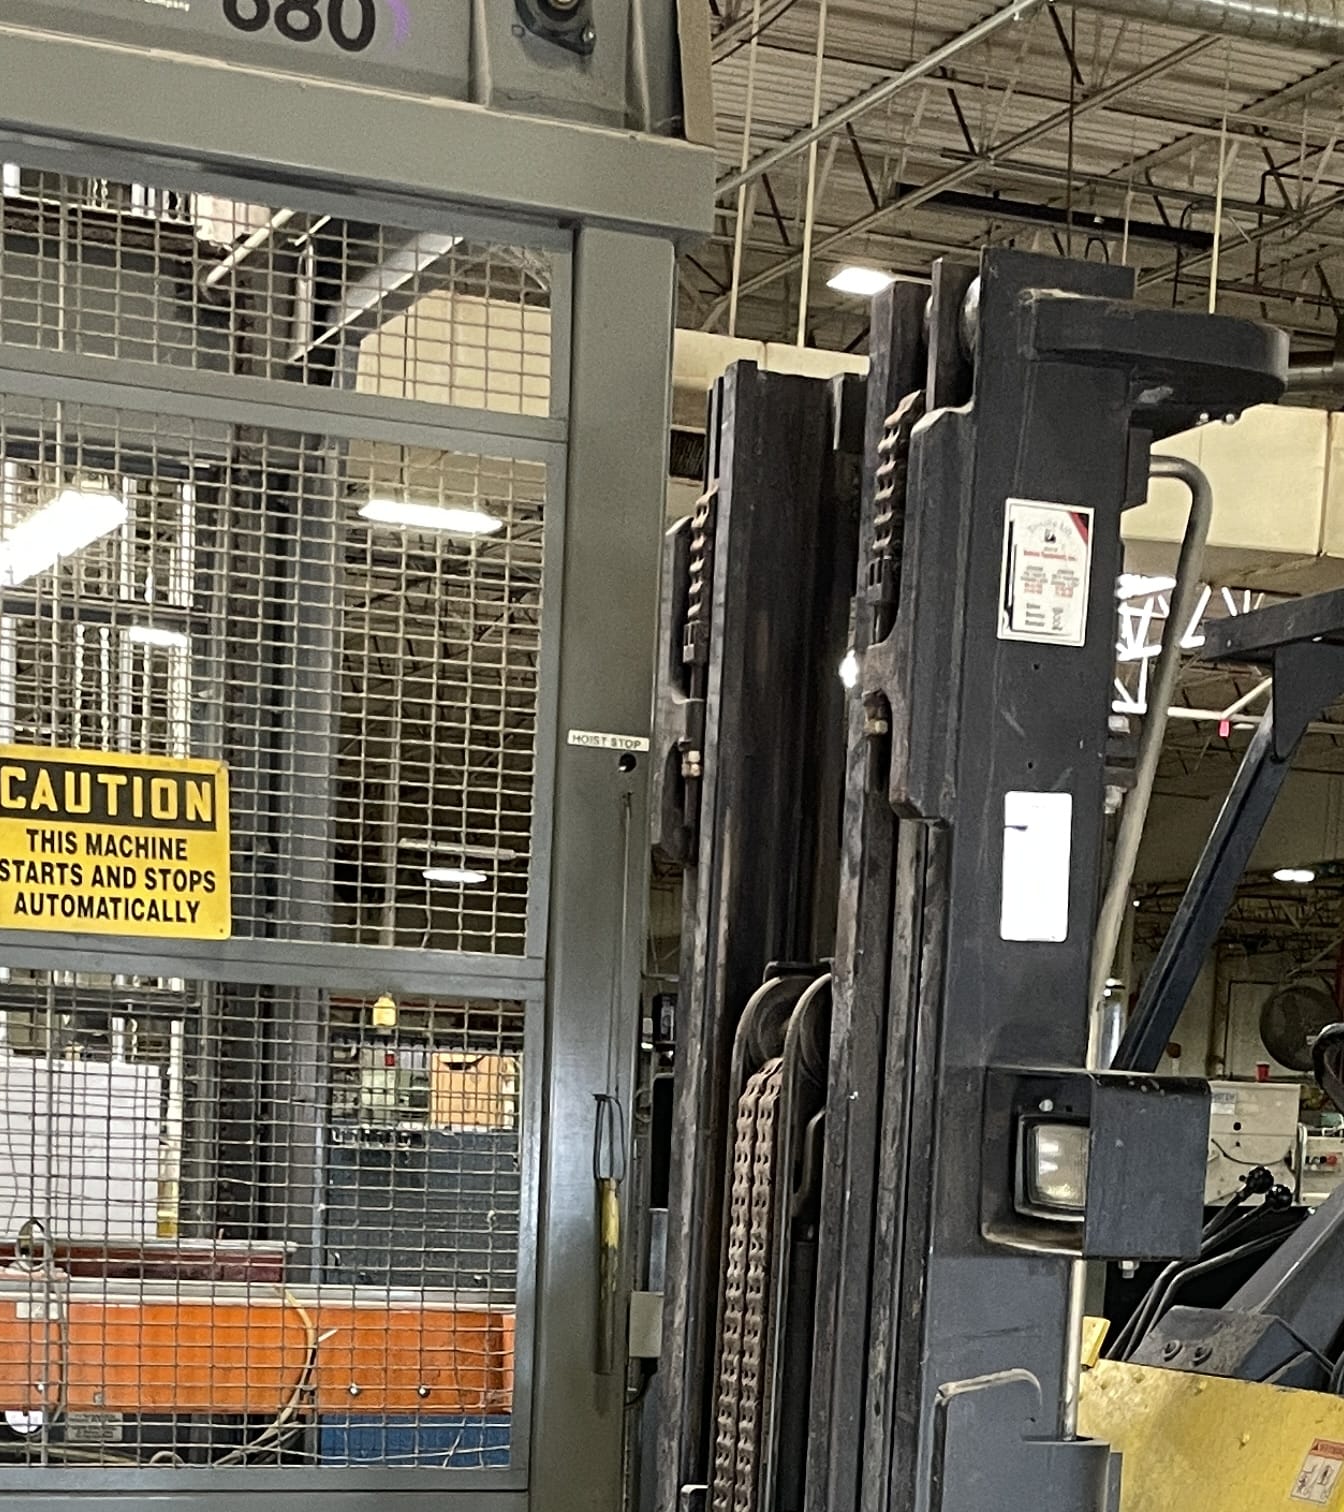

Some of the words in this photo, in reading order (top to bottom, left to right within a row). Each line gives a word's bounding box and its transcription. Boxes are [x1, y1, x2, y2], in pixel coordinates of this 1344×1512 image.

[572, 734, 607, 746] HOIST
[610, 738, 642, 749] STOP
[0, 765, 212, 822] CAUTION
[26, 828, 78, 855] THIS
[86, 833, 188, 861] MACHINE
[91, 865, 136, 889] AND
[144, 868, 216, 893] STOPS
[13, 892, 201, 923] AUTOMATICALLY
